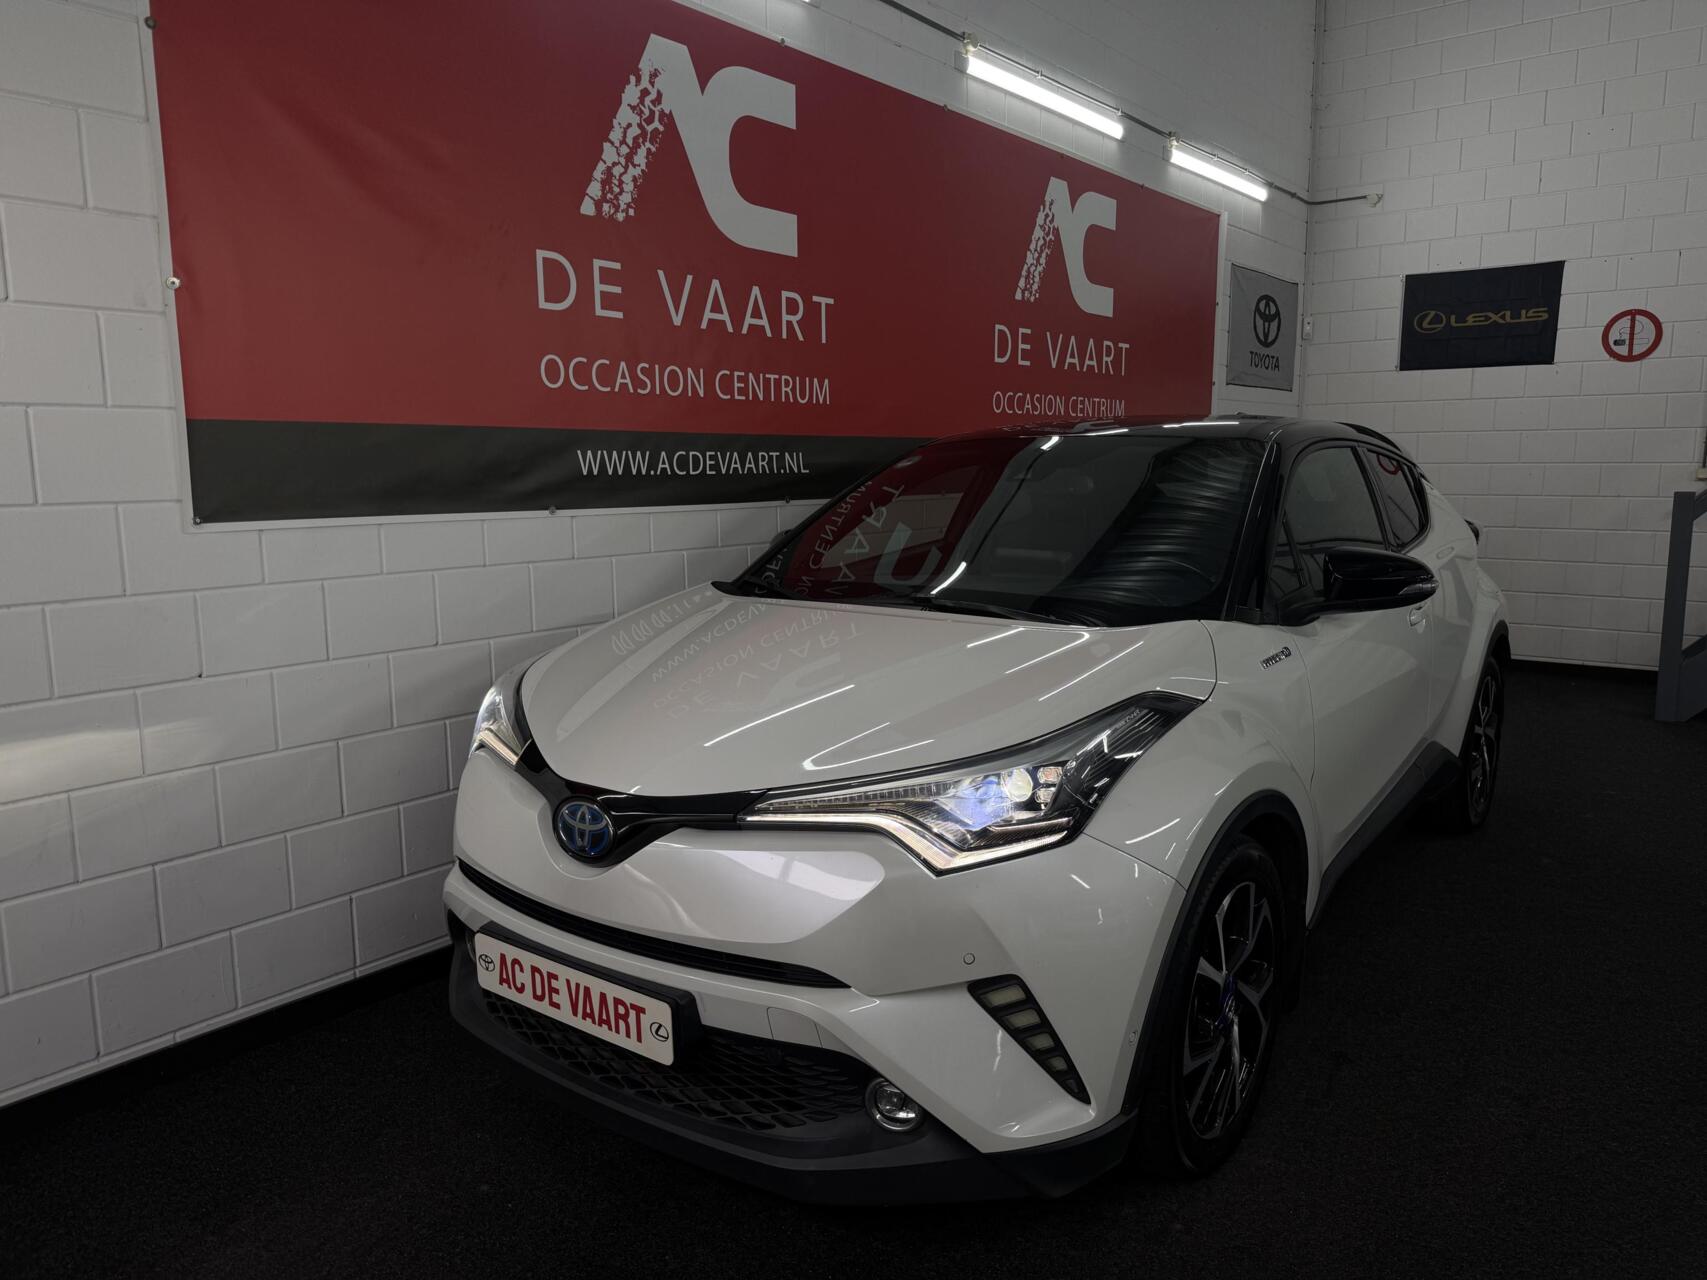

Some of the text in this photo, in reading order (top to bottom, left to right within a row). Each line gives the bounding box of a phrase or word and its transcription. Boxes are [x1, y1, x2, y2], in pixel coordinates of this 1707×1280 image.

[580, 33, 799, 258] AC
[1014, 176, 1117, 318] AC
[535, 248, 835, 343] DE VAART
[1450, 307, 1549, 327] LEXUS
[994, 324, 1130, 376] DE VAART
[1249, 350, 1280, 372] TOYOTA
[540, 354, 831, 404] OCCASION CENTRUM
[992, 391, 1125, 418] OCCASION CENTRUM
[577, 449, 810, 476] WWW.ACDEVAART.NL
[498, 952, 647, 1044] AC DE VAART
